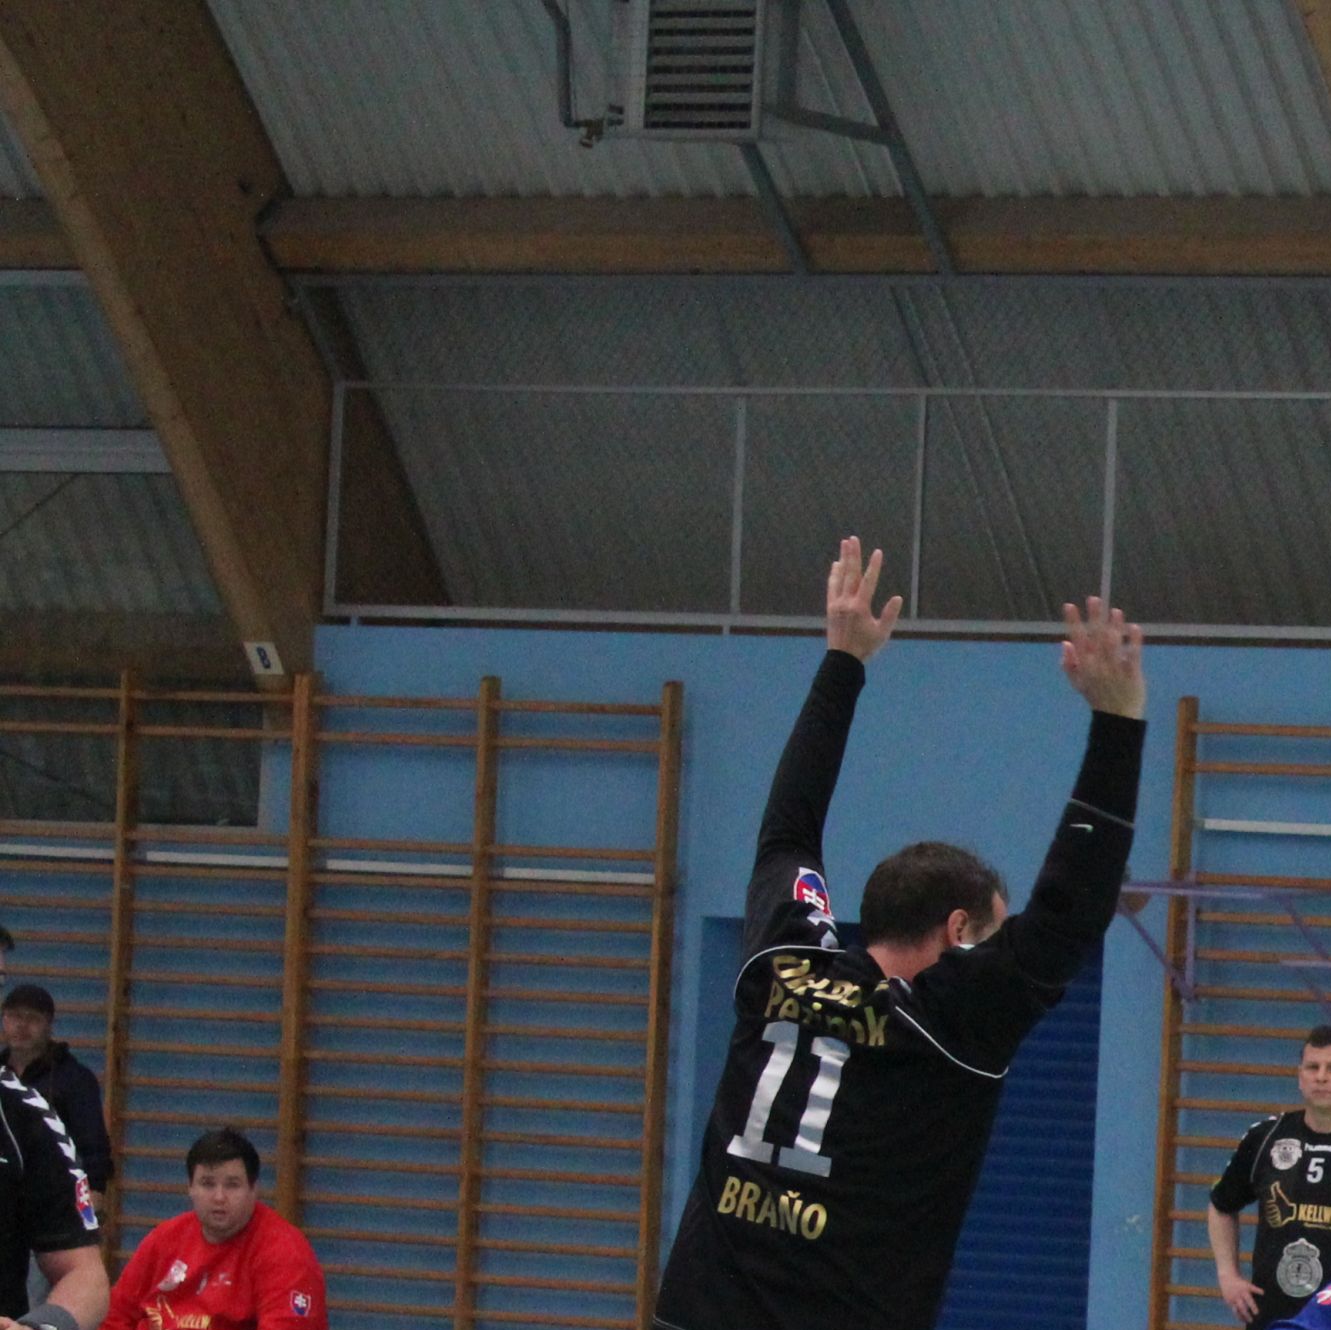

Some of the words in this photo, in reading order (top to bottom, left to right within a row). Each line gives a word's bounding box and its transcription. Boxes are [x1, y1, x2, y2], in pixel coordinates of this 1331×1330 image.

[726, 1020, 851, 1178] 11
[1306, 1157, 1325, 1184] 5
[717, 1175, 828, 1241] BRAŇO
